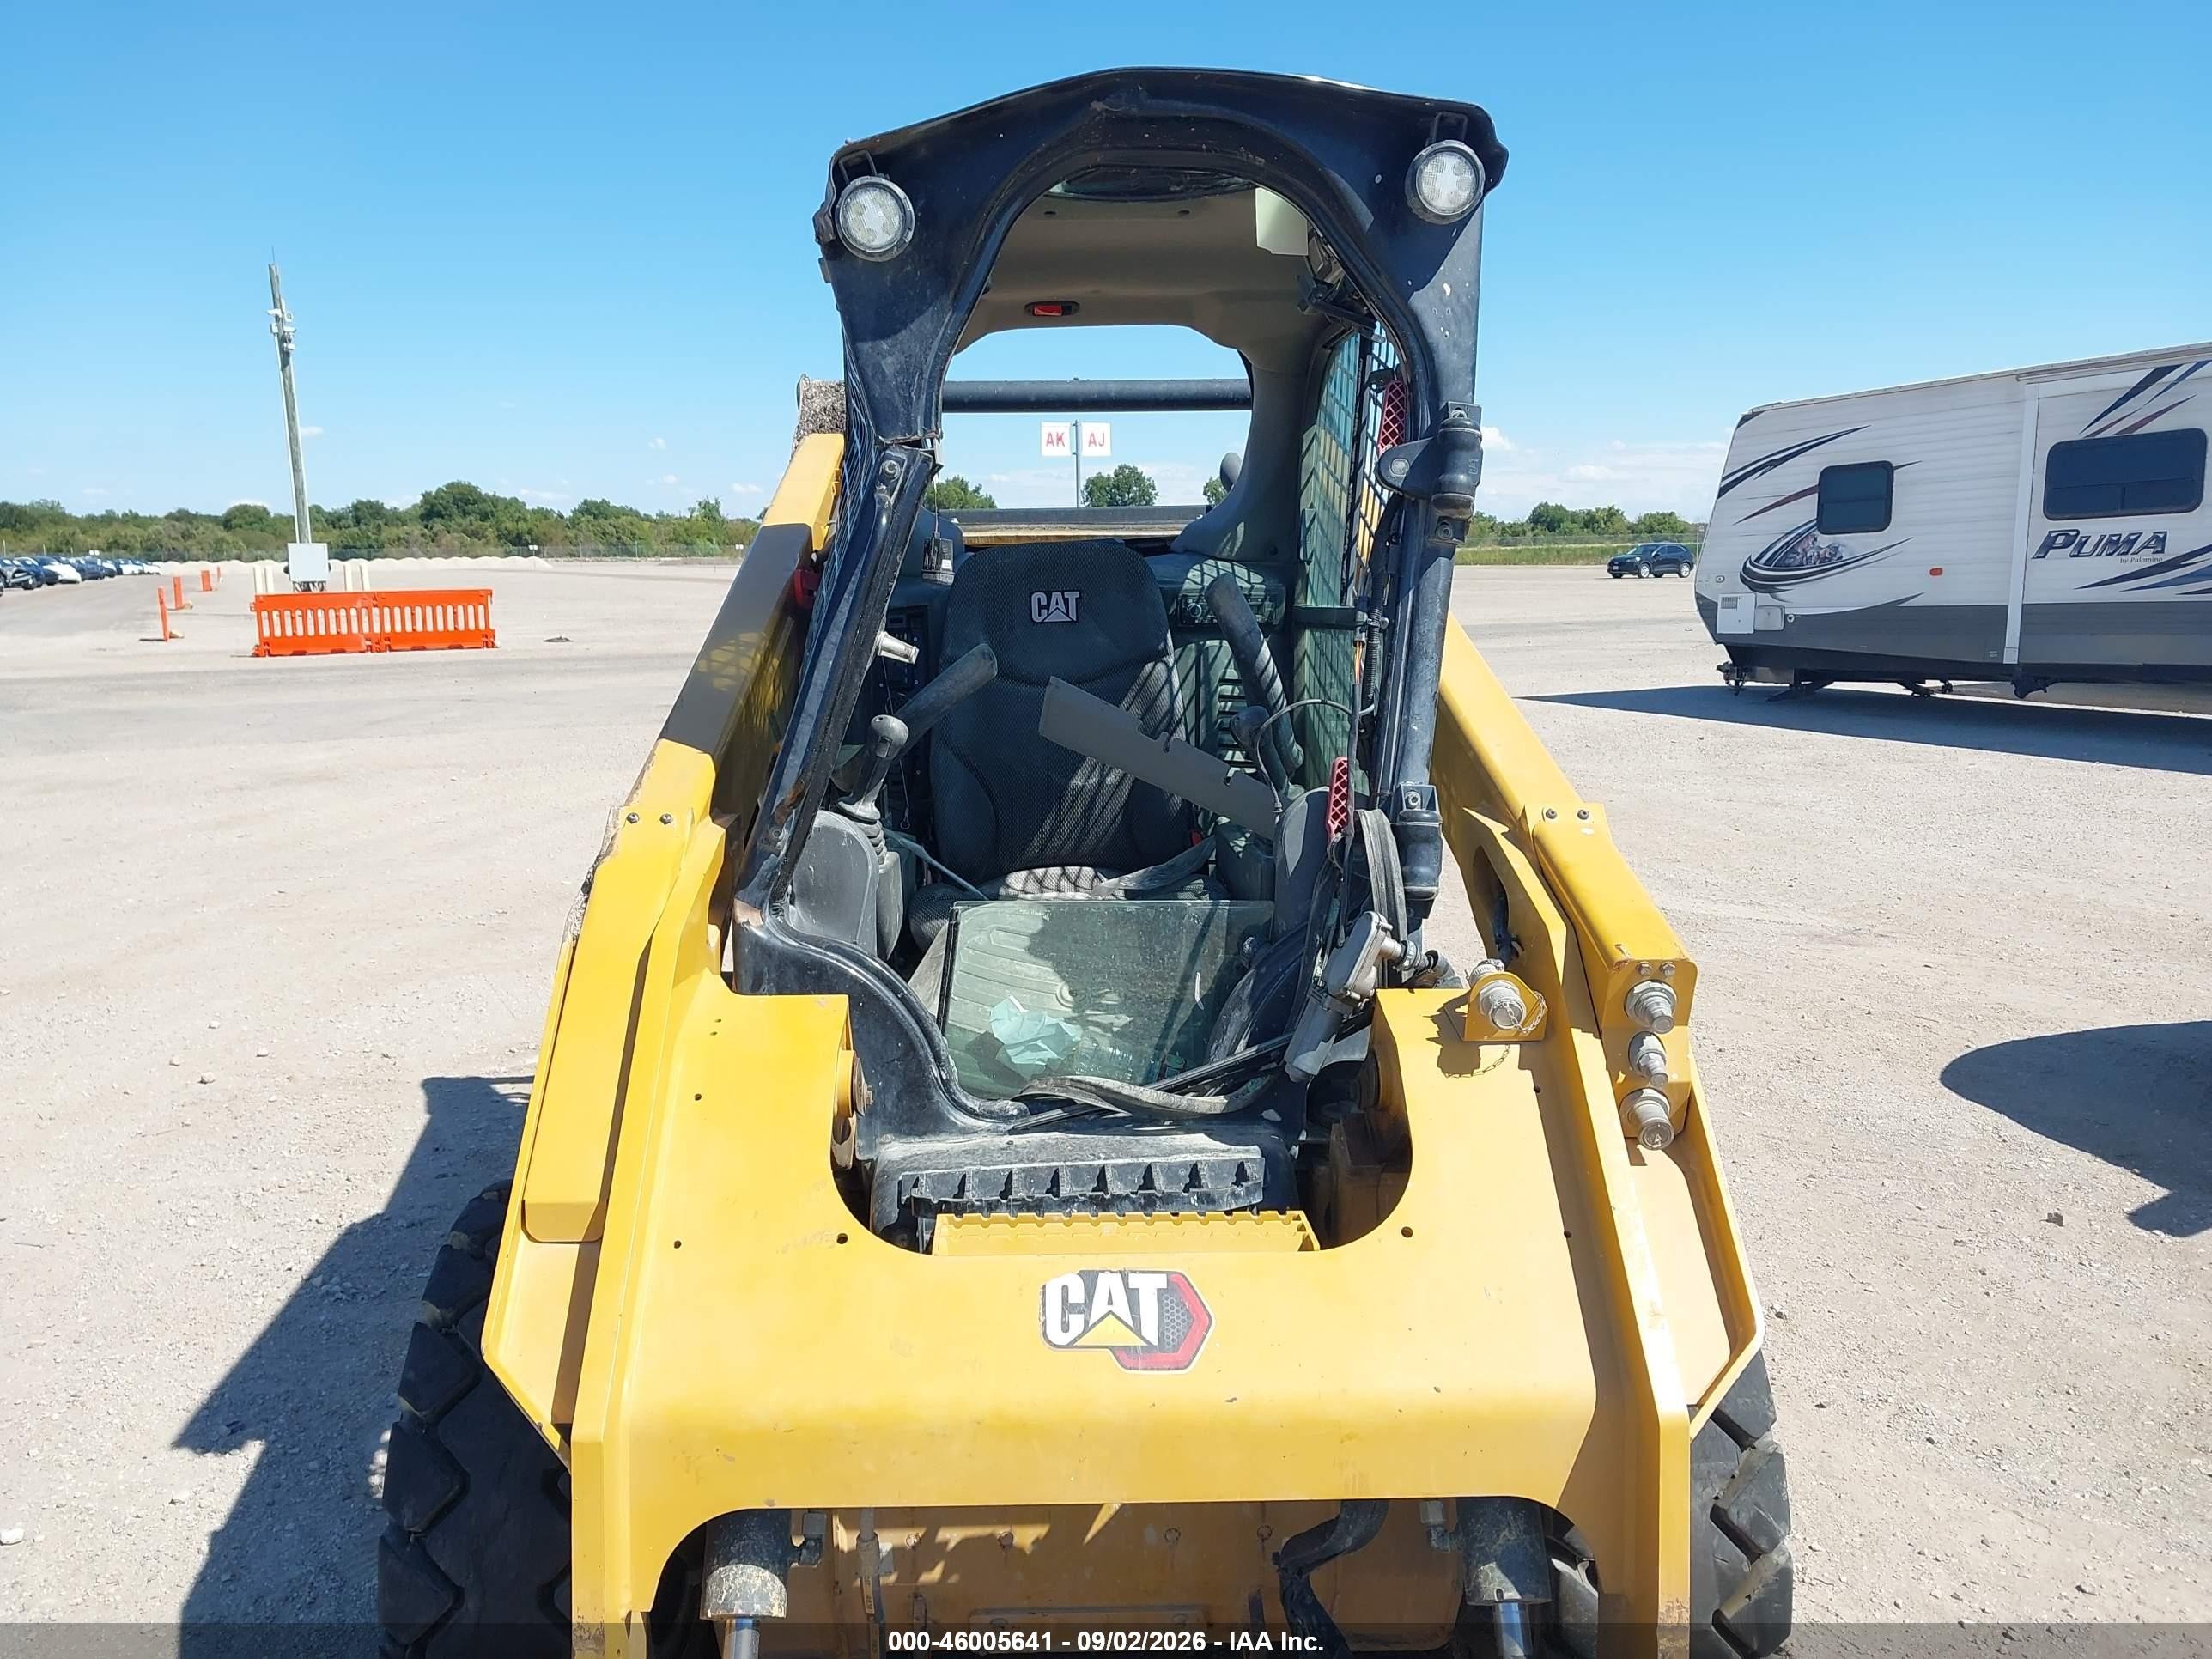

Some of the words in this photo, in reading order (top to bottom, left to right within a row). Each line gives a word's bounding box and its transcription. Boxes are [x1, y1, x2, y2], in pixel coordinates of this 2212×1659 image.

[1046, 431, 1066, 447] AK
[1088, 432, 1105, 447] AJ
[2032, 529, 2169, 560] PUMA
[2130, 556, 2164, 564] Palomino
[1031, 591, 1080, 623] CAT
[1044, 1273, 1168, 1346] CAT
